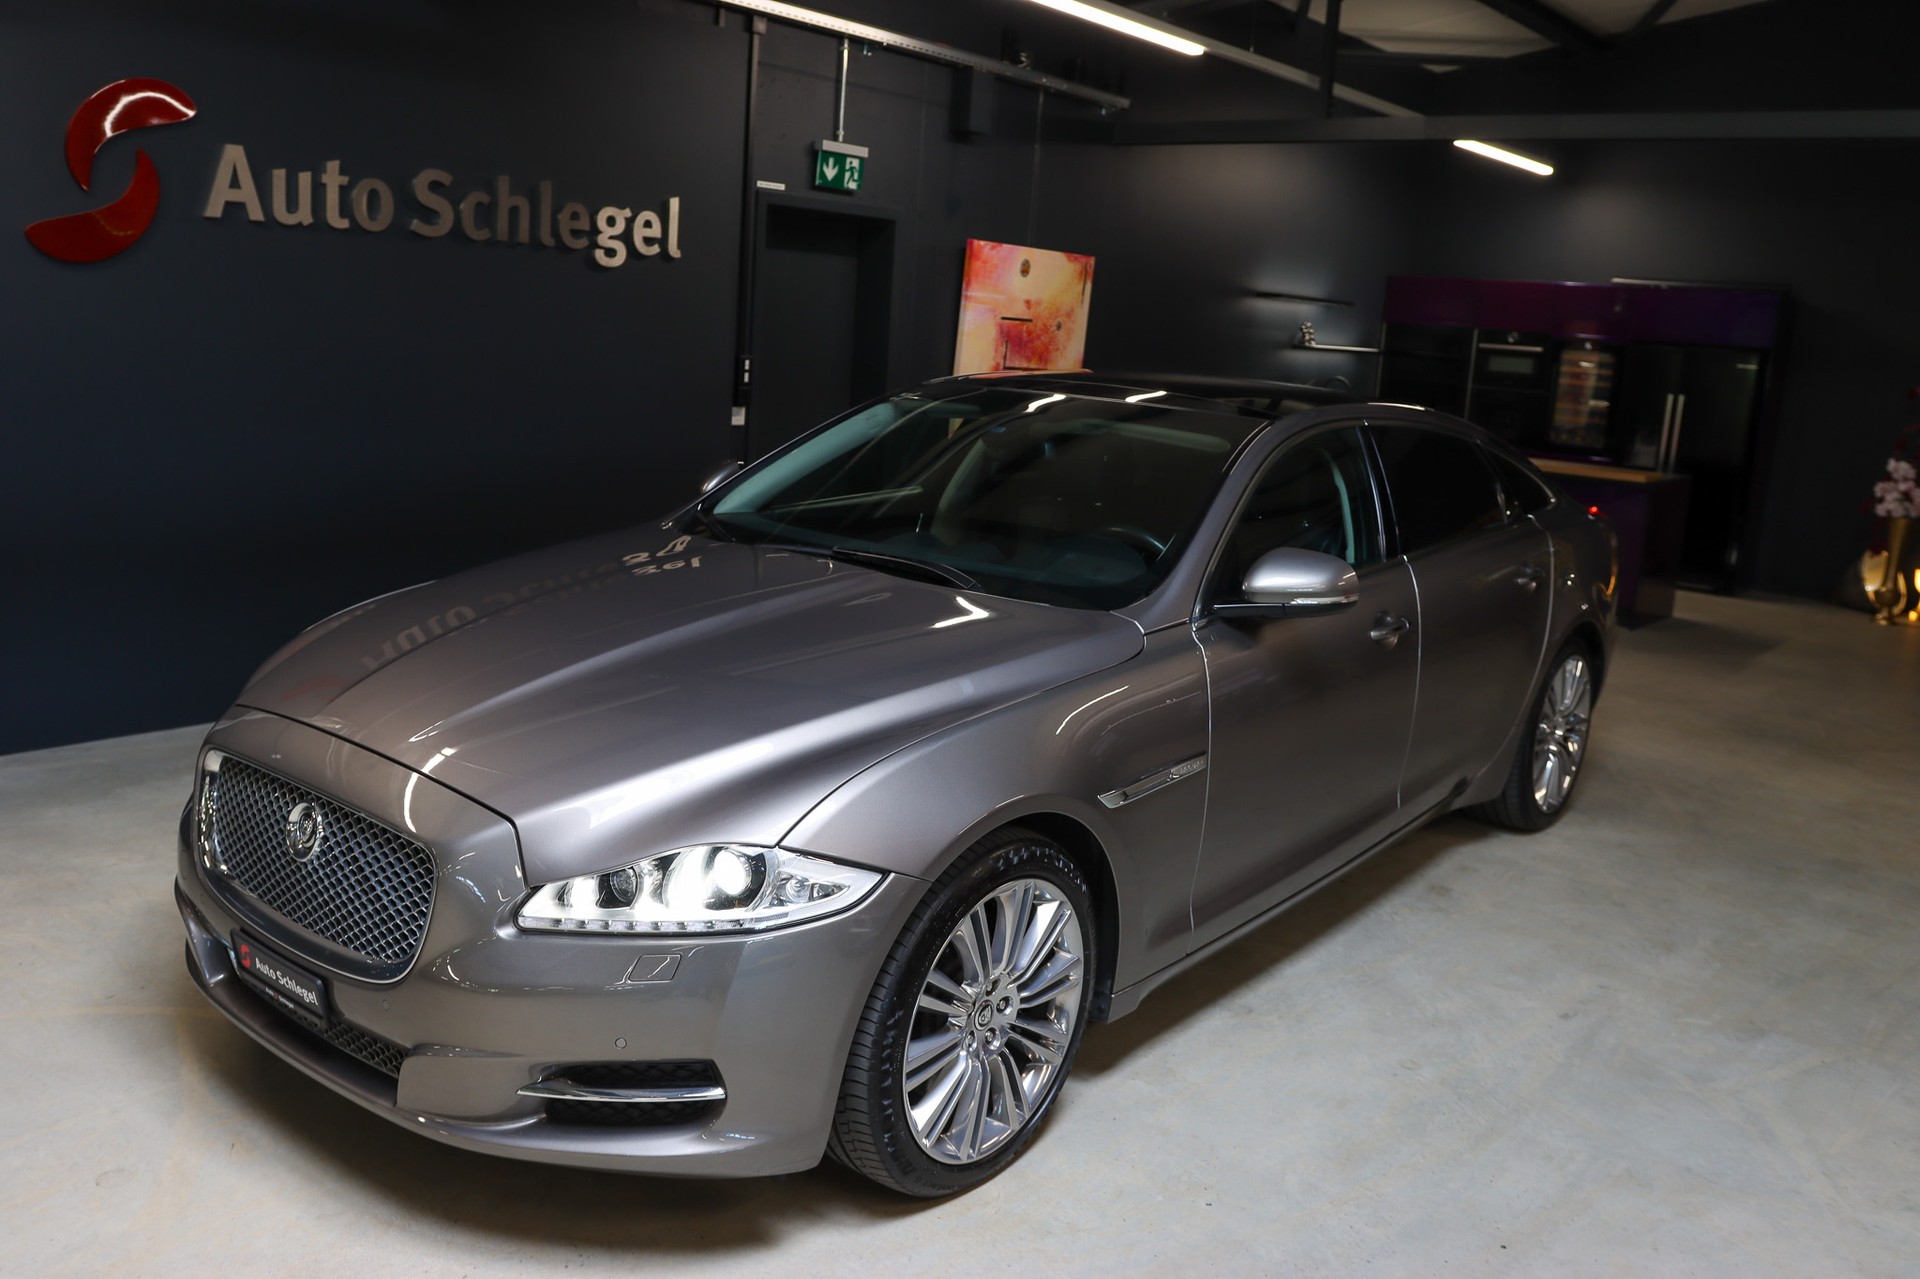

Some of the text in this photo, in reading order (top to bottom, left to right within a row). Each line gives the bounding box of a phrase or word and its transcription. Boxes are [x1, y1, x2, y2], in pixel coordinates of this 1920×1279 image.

[203, 143, 682, 268] Auto Schlegel
[255, 957, 276, 980] Auto
[276, 970, 318, 1006] Schlegel
